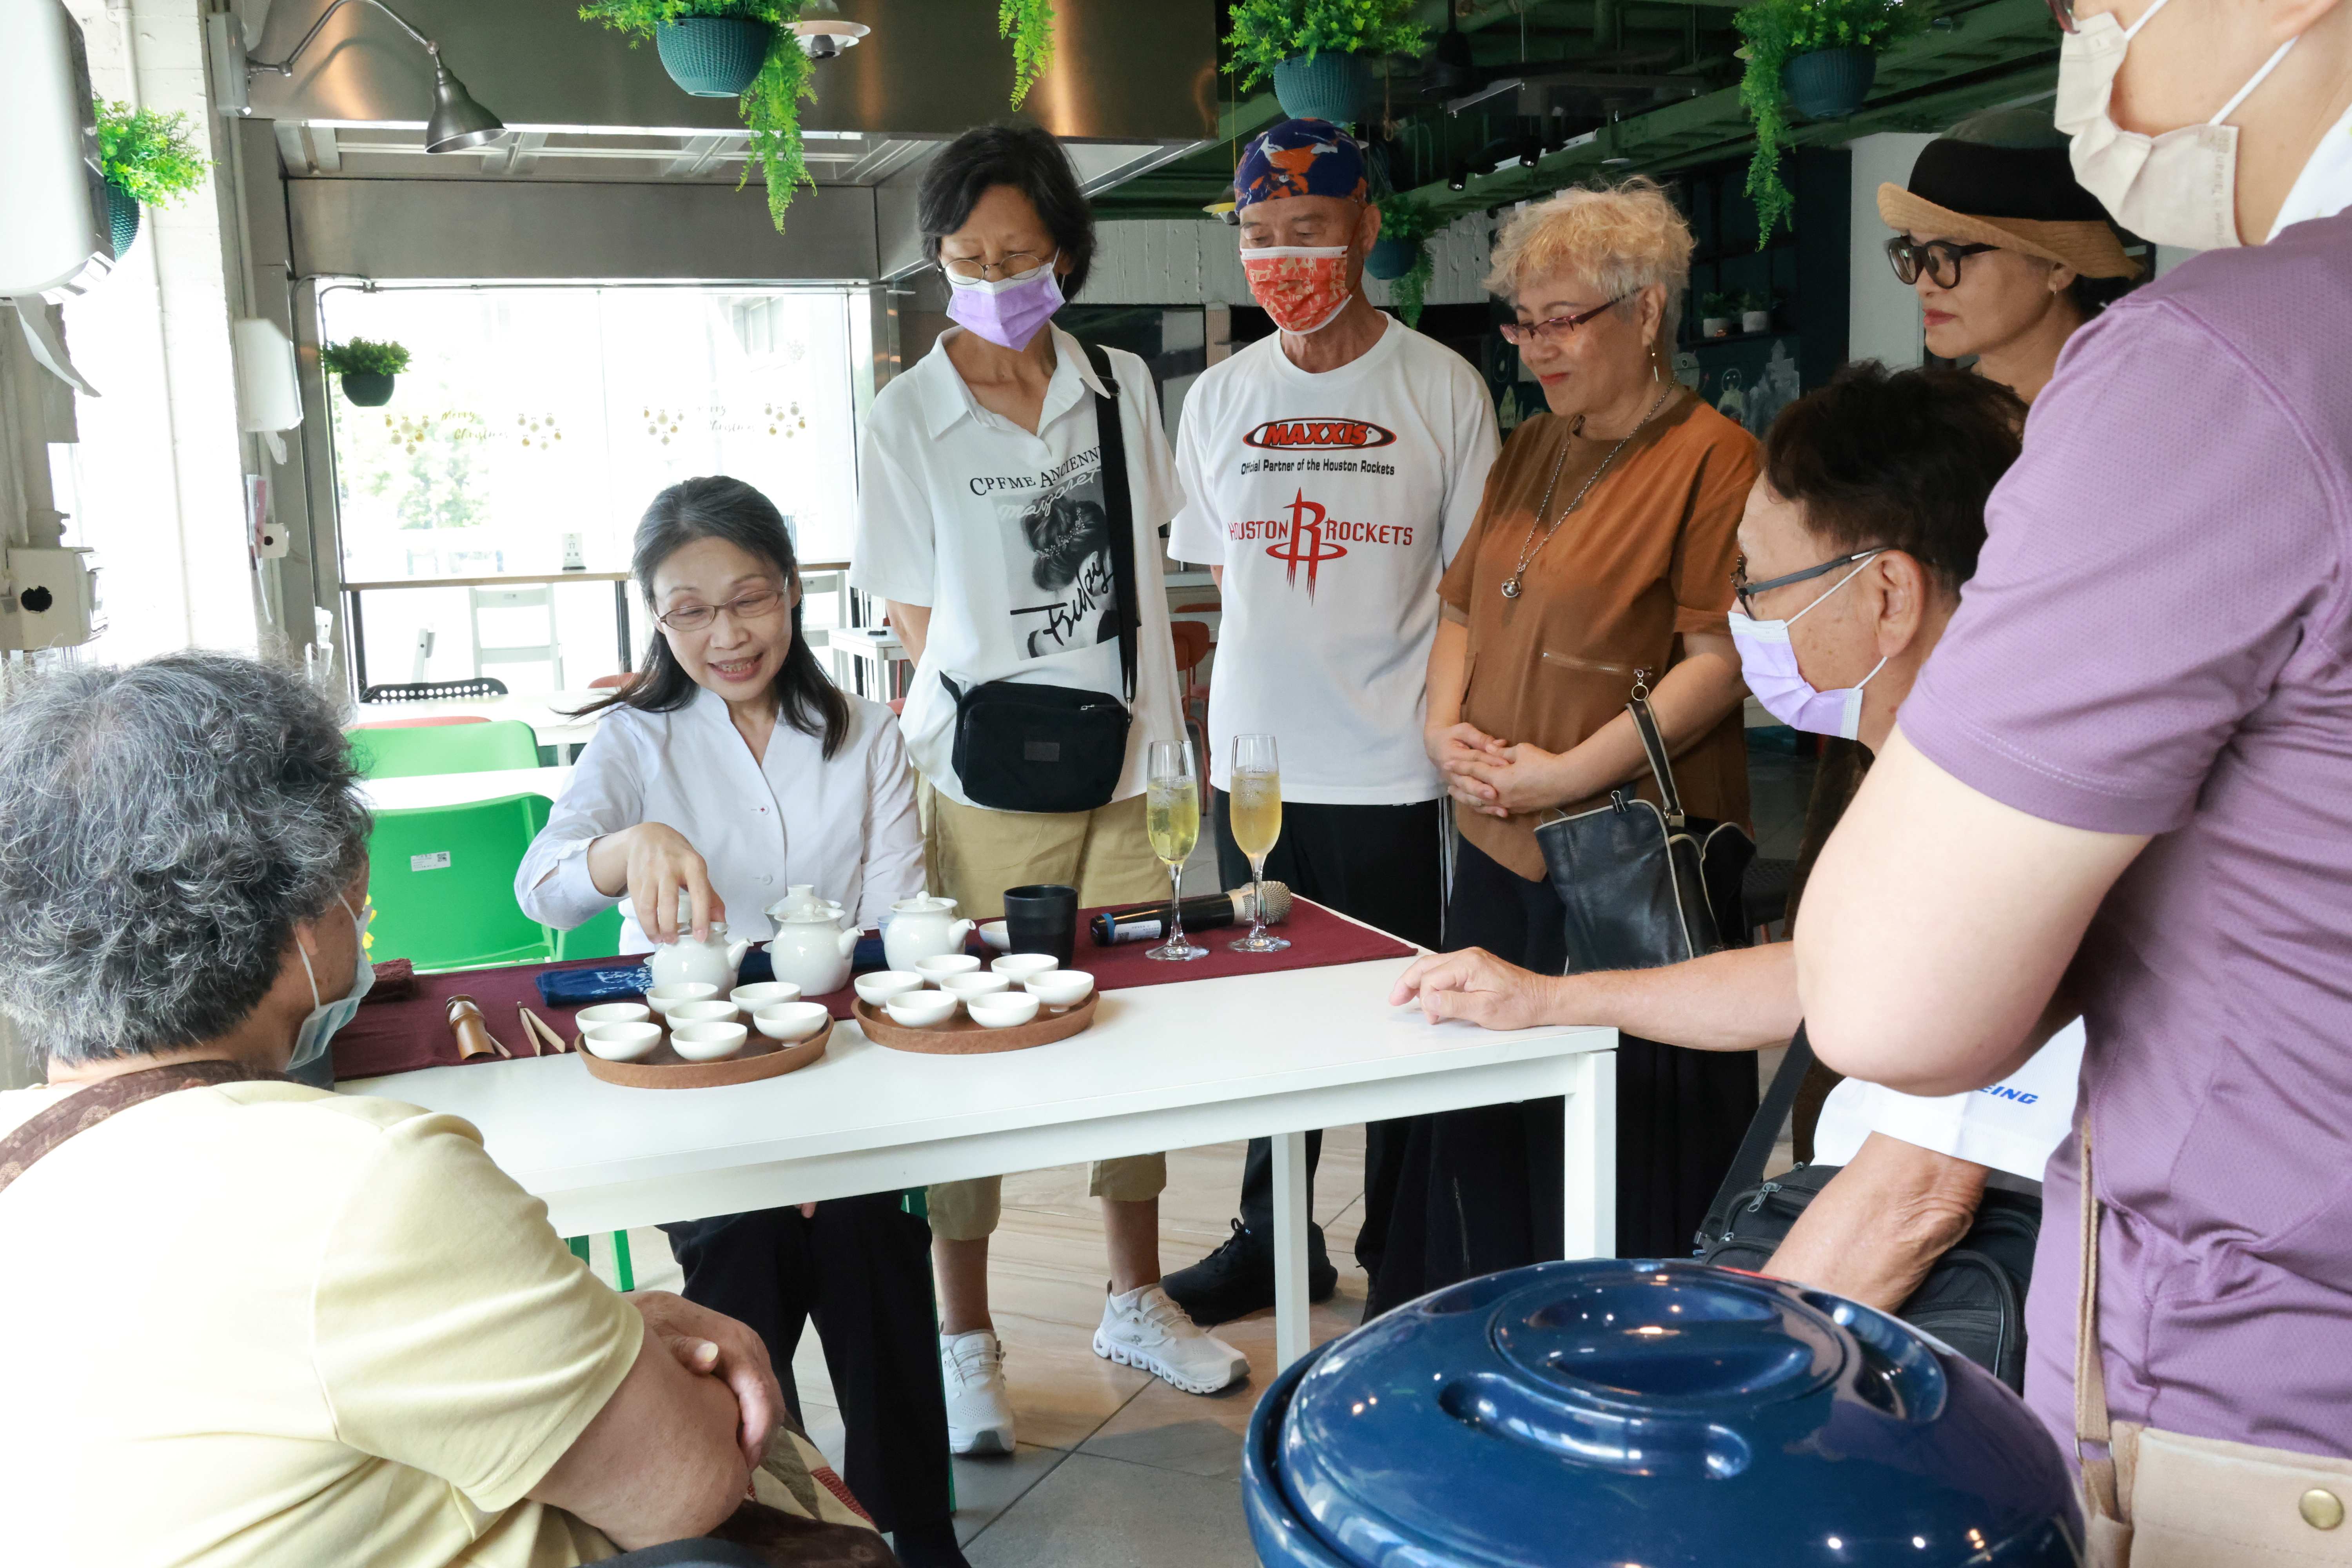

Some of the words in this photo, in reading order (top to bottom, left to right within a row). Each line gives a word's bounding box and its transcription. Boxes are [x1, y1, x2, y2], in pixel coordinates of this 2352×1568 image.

[1262, 423, 1368, 446] MAXXIS
[1040, 446, 1101, 488] ANCIENN
[1241, 459, 1260, 475] Official
[1263, 459, 1294, 471] Partner
[1297, 458, 1305, 470] of
[1307, 458, 1320, 470] the
[1323, 458, 1357, 472] Houston
[1361, 460, 1394, 475] Rockets
[1228, 519, 1288, 541] HOUSTON
[1325, 517, 1413, 545] ROCKETS
